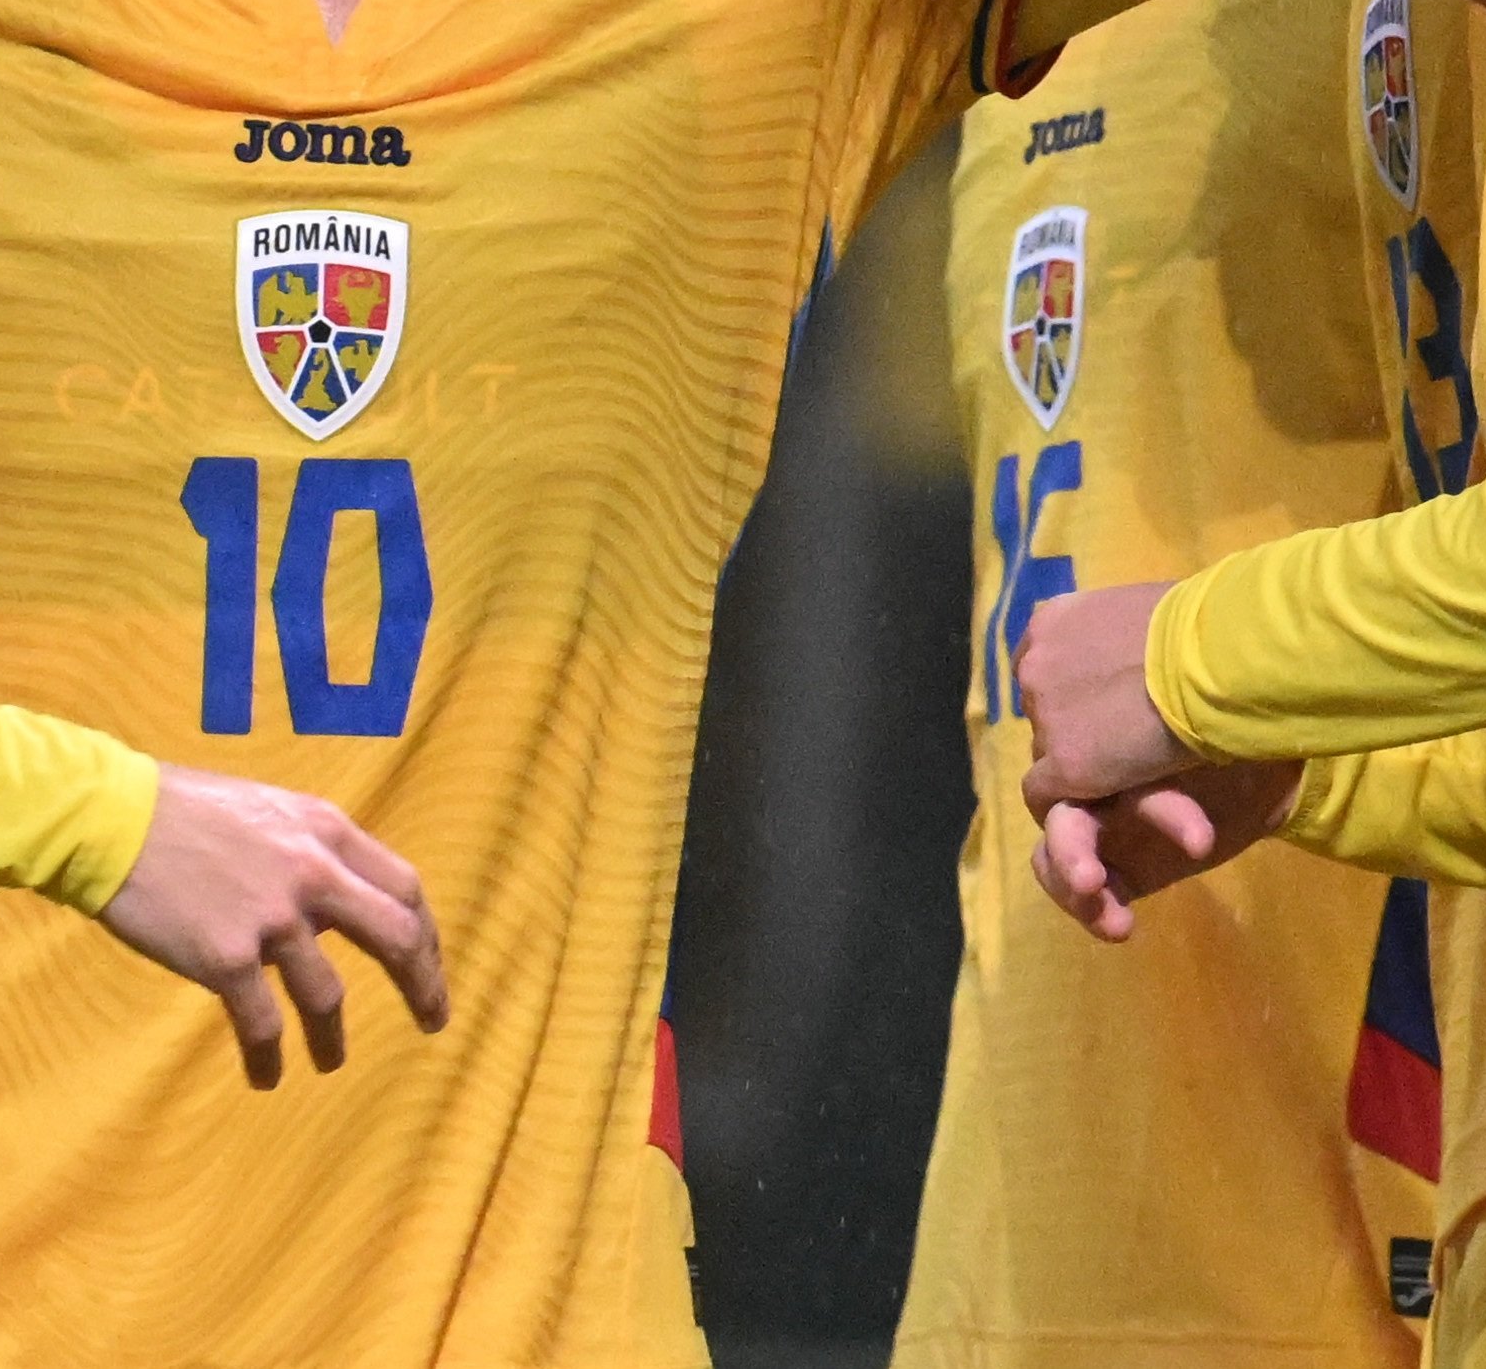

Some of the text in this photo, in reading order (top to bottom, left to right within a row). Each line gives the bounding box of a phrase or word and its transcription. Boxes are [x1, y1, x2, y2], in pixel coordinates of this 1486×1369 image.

[234, 120, 411, 166] Joma
[254, 216, 390, 260] ROMÂNIA
[180, 457, 433, 737] 10
